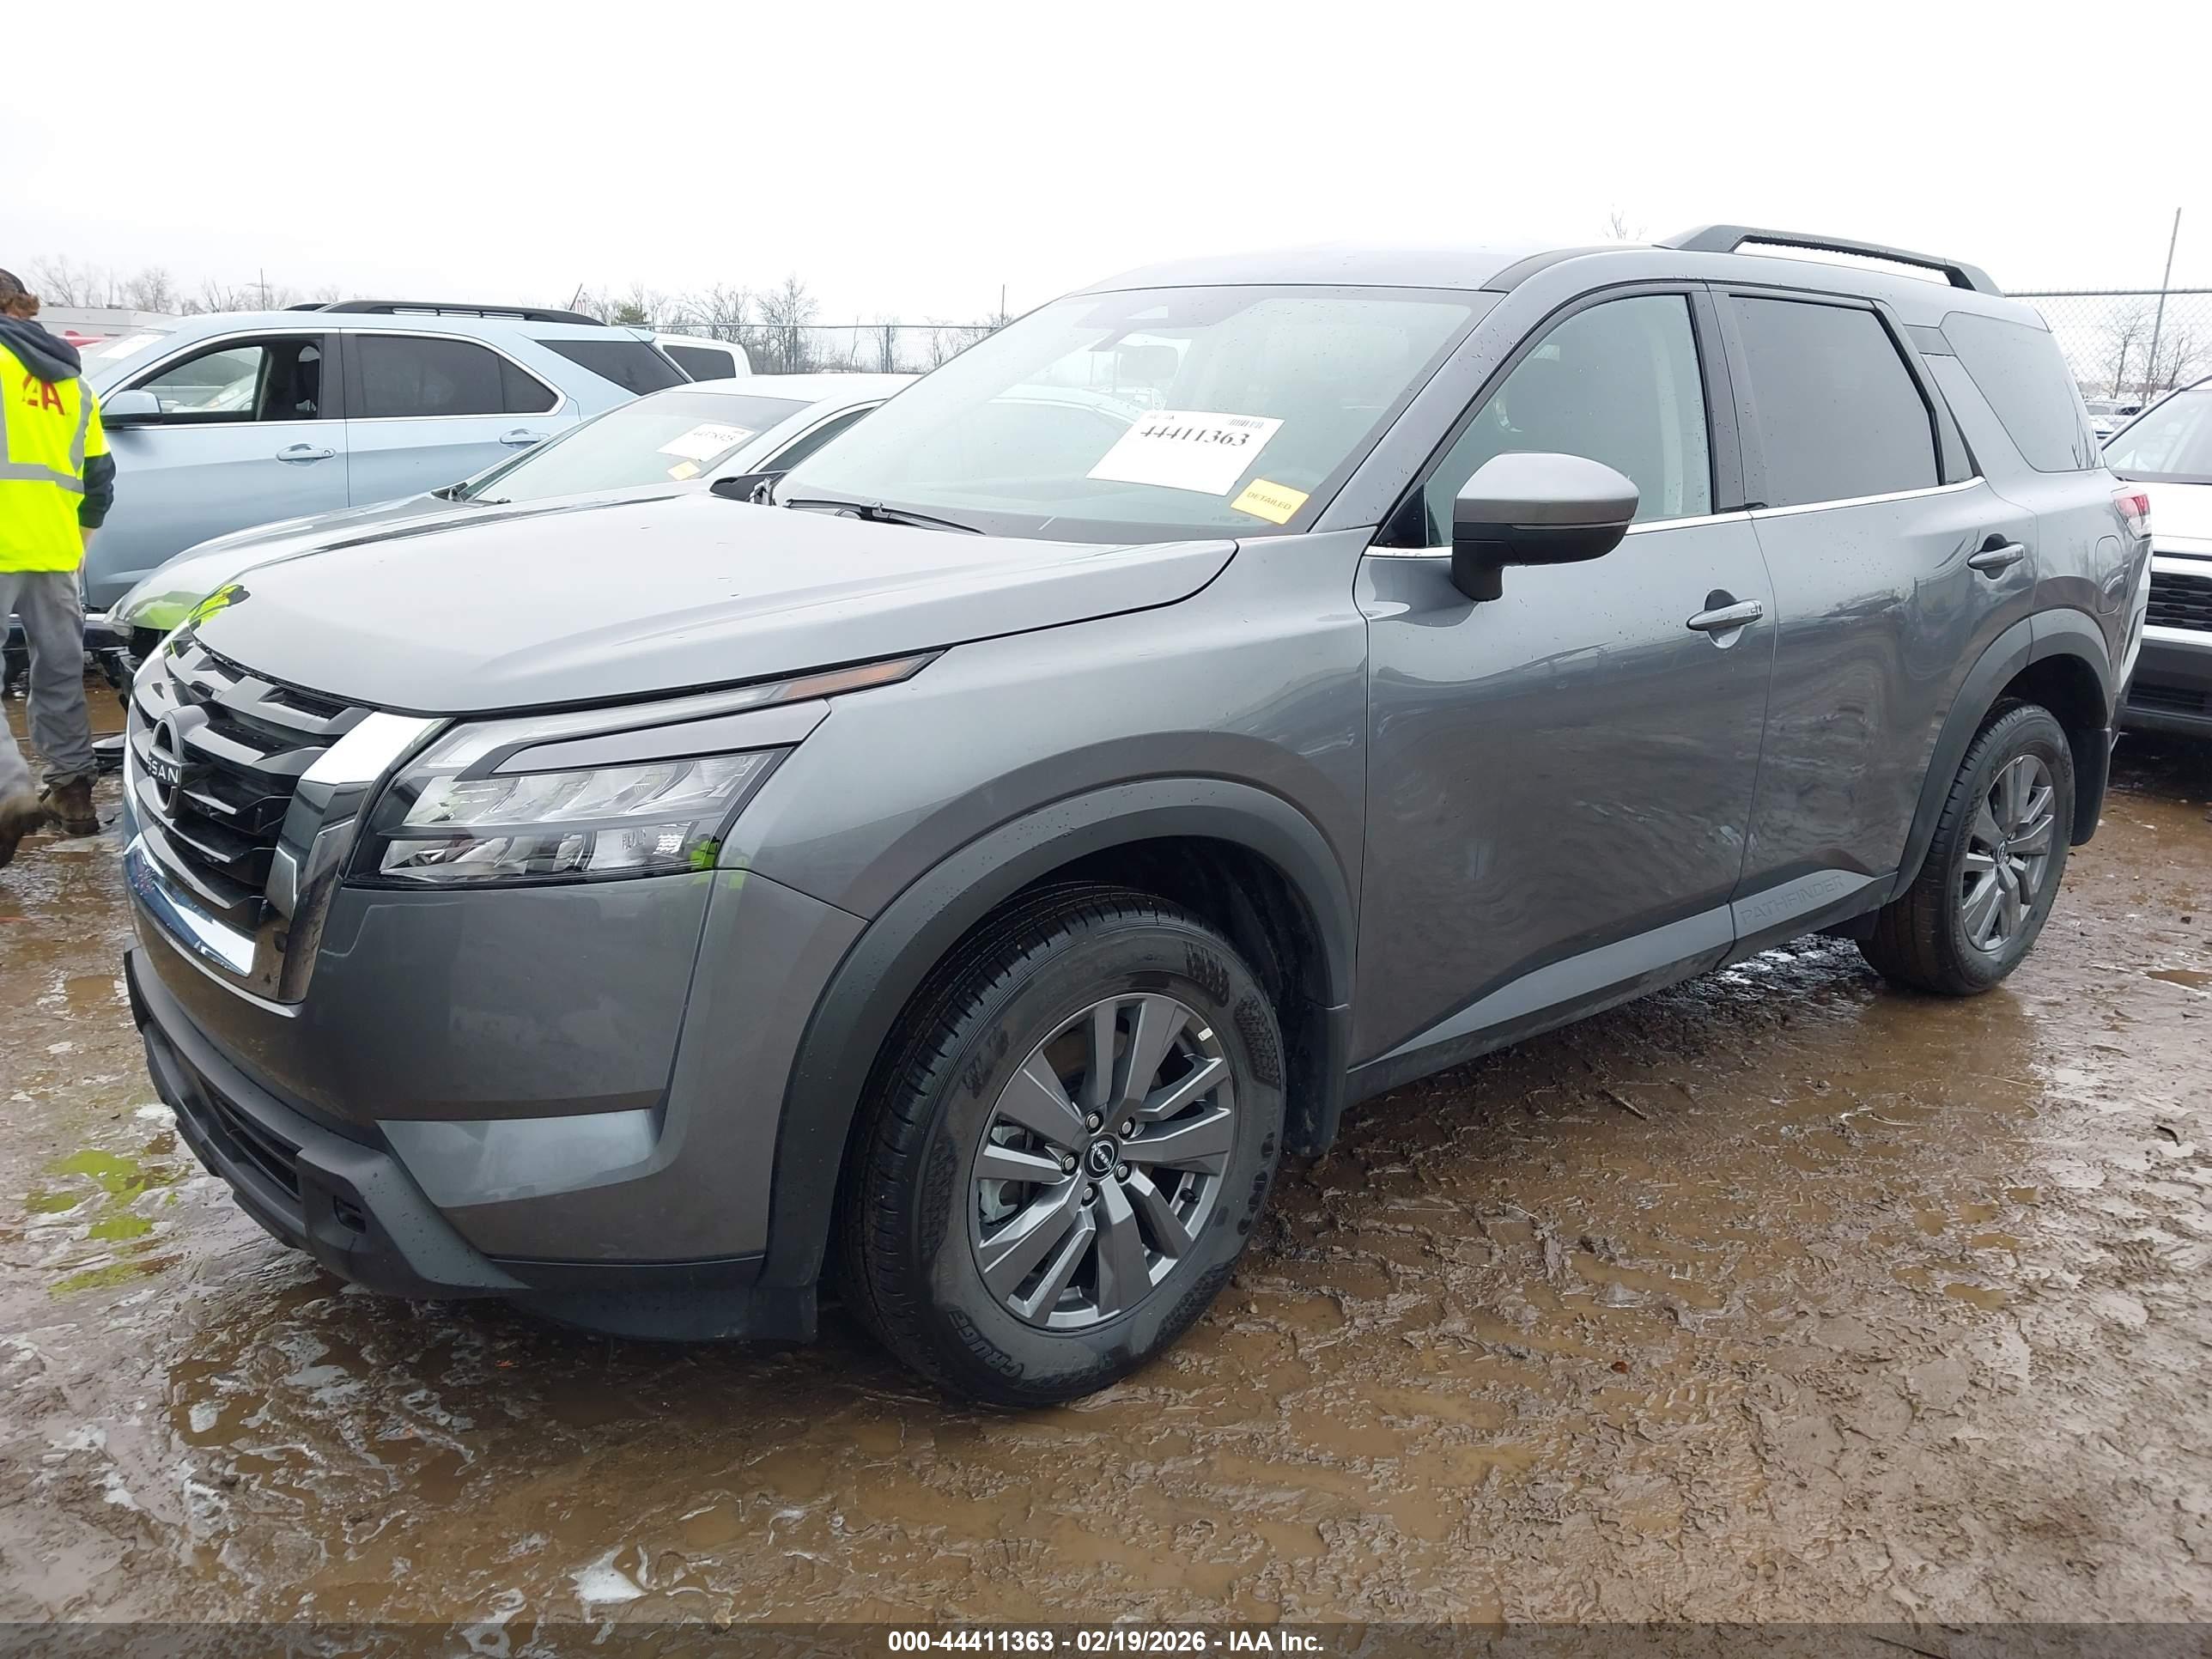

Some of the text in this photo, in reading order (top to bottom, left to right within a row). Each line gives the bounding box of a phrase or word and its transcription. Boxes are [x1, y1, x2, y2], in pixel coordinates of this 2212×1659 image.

[1140, 425, 1250, 447] 44411363
[1246, 490, 1292, 511] DETAILED
[1740, 874, 1845, 926] PATHFINDER
